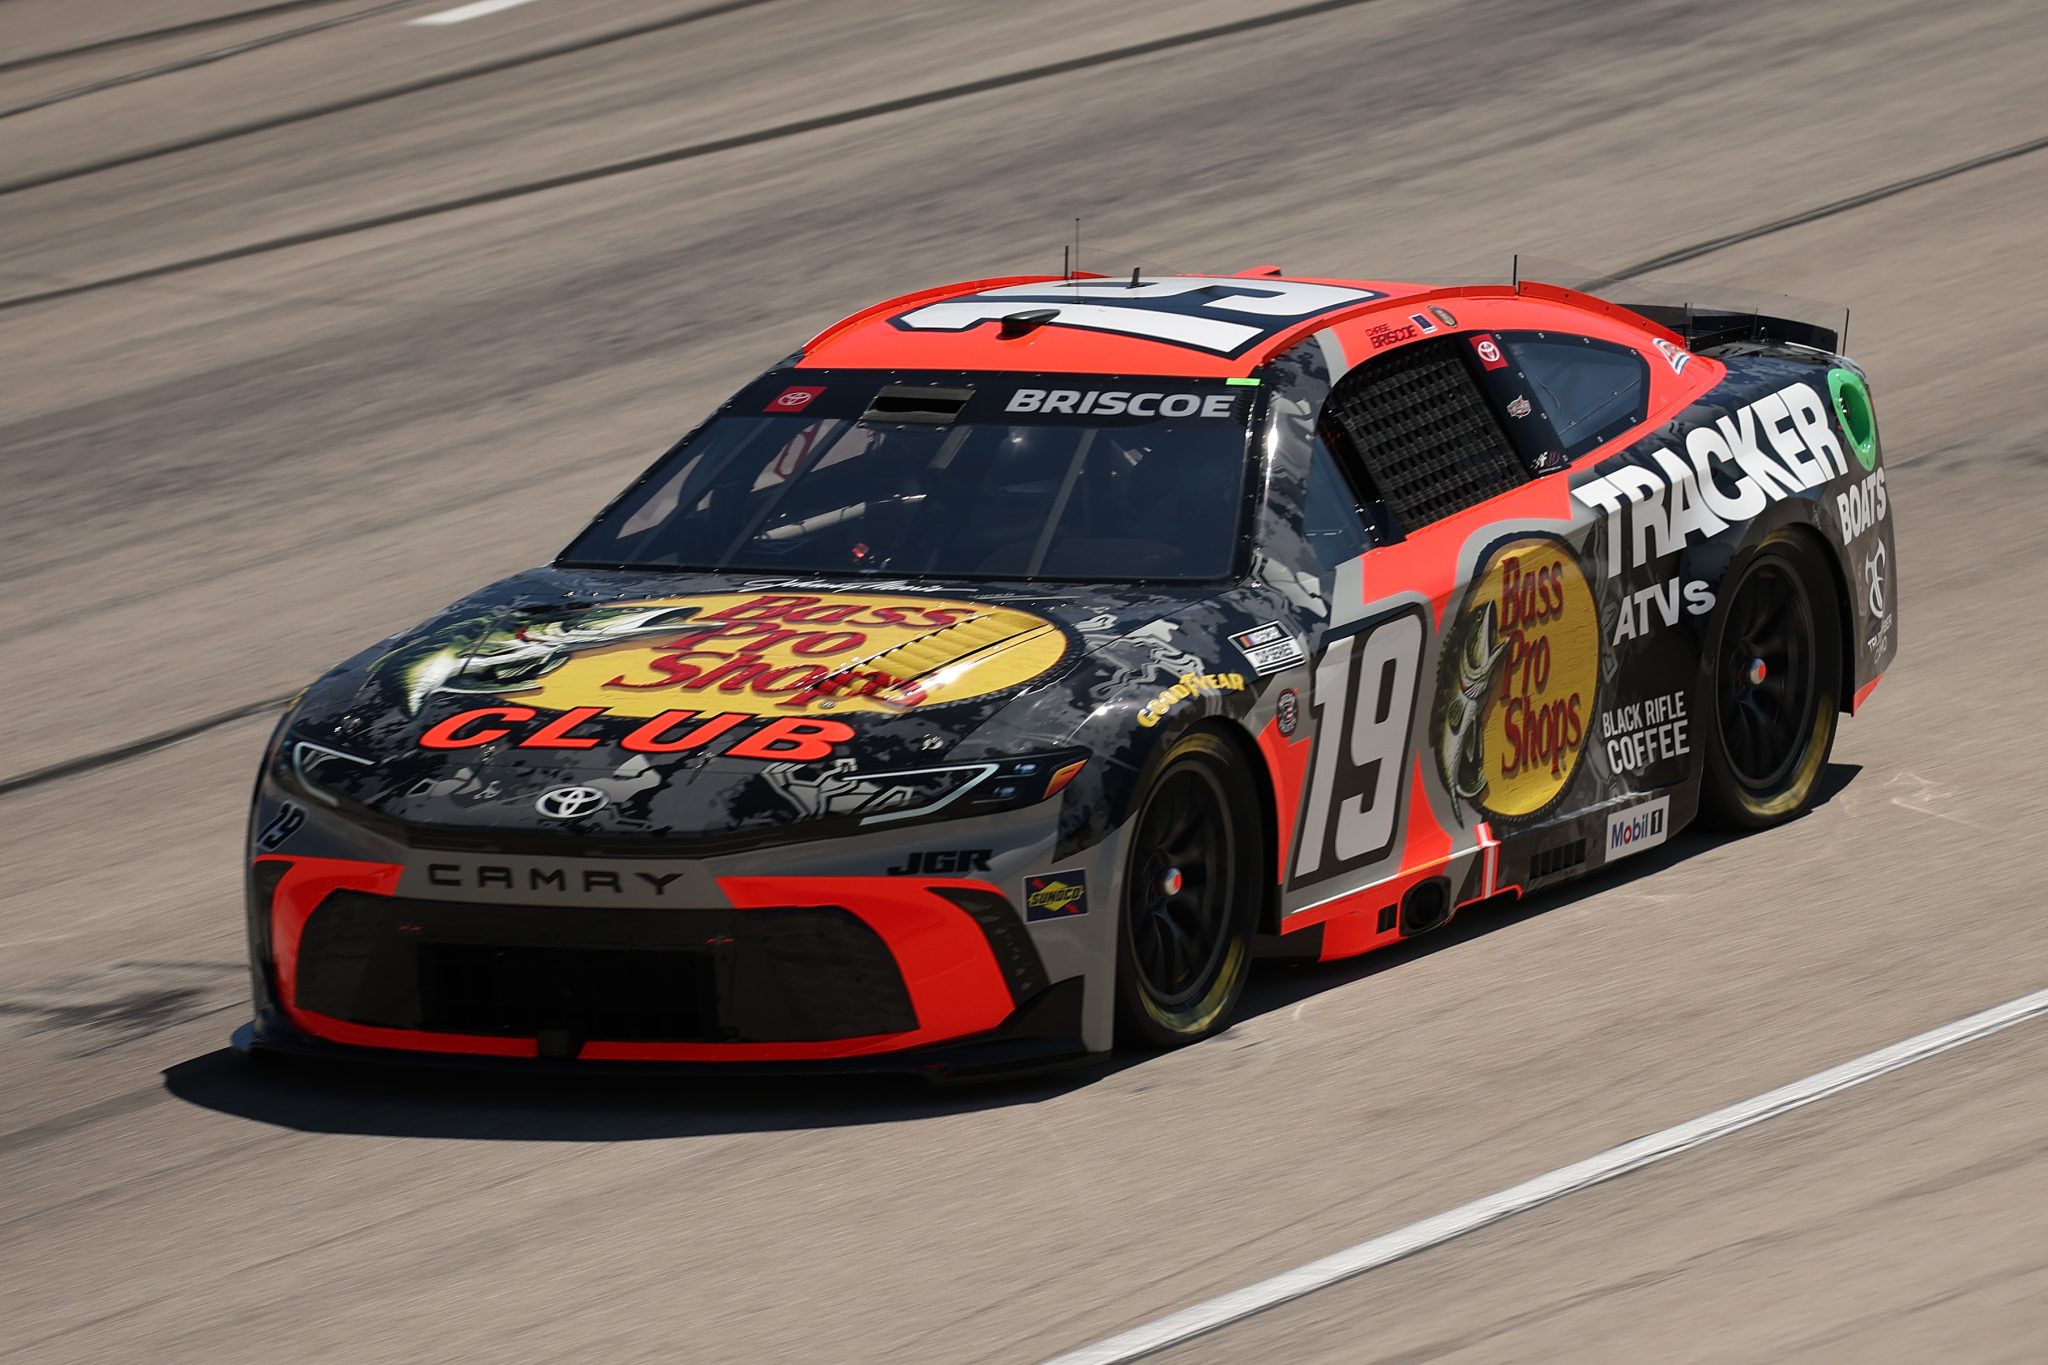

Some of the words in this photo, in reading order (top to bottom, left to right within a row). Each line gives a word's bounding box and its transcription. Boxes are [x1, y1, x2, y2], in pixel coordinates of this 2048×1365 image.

[1005, 388, 1236, 419] BRISCOE
[1571, 382, 1849, 578] TRACKER
[1837, 466, 1887, 546] BOATS
[692, 595, 978, 628] Bass
[1499, 556, 1563, 632] Bass
[651, 619, 867, 657] Pro
[1500, 628, 1551, 702] Pro
[601, 650, 929, 707] Shops
[1136, 671, 1245, 728] GOODYEAR
[419, 706, 857, 761] CLUB
[1501, 692, 1583, 778] Shops
[1602, 702, 1643, 739] BLACK
[1644, 690, 1686, 727] RIFLE
[1294, 614, 1422, 878] 19
[1606, 718, 1690, 775] COFFEE
[1611, 813, 1649, 849] Mobil
[426, 863, 686, 897] CAMRY
[886, 848, 993, 876] JGR
[1029, 886, 1082, 906] SUNOCO
